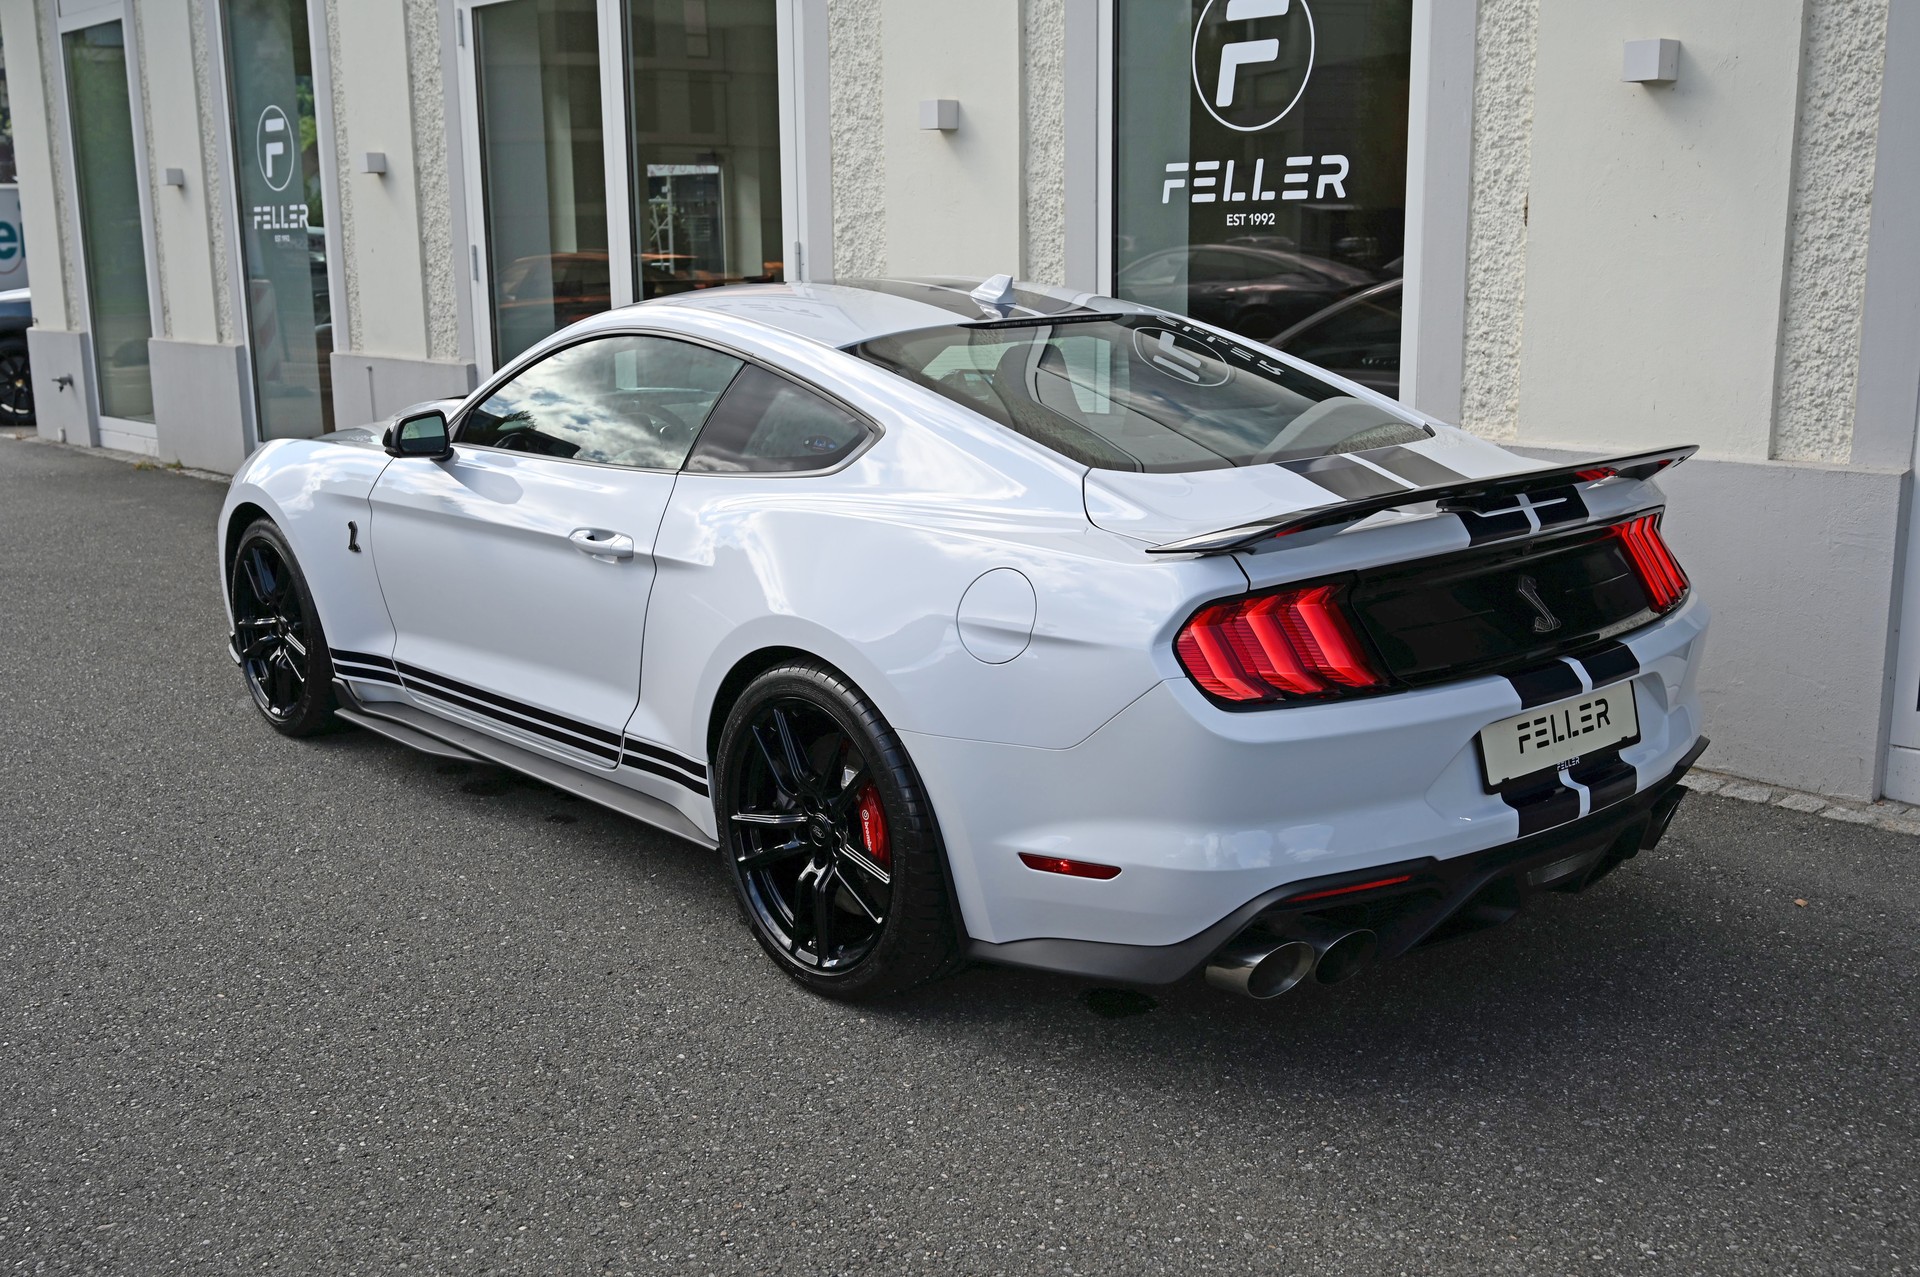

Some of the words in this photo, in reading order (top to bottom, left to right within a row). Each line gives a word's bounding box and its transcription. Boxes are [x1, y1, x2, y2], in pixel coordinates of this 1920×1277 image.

[1162, 154, 1350, 204] FELLER
[253, 204, 310, 230] FELLER
[1226, 214, 1246, 227] EST
[1248, 213, 1275, 226] 1992
[1516, 698, 1611, 754] FELLER
[1557, 757, 1580, 771] FELLER
[864, 821, 873, 851] brembo
